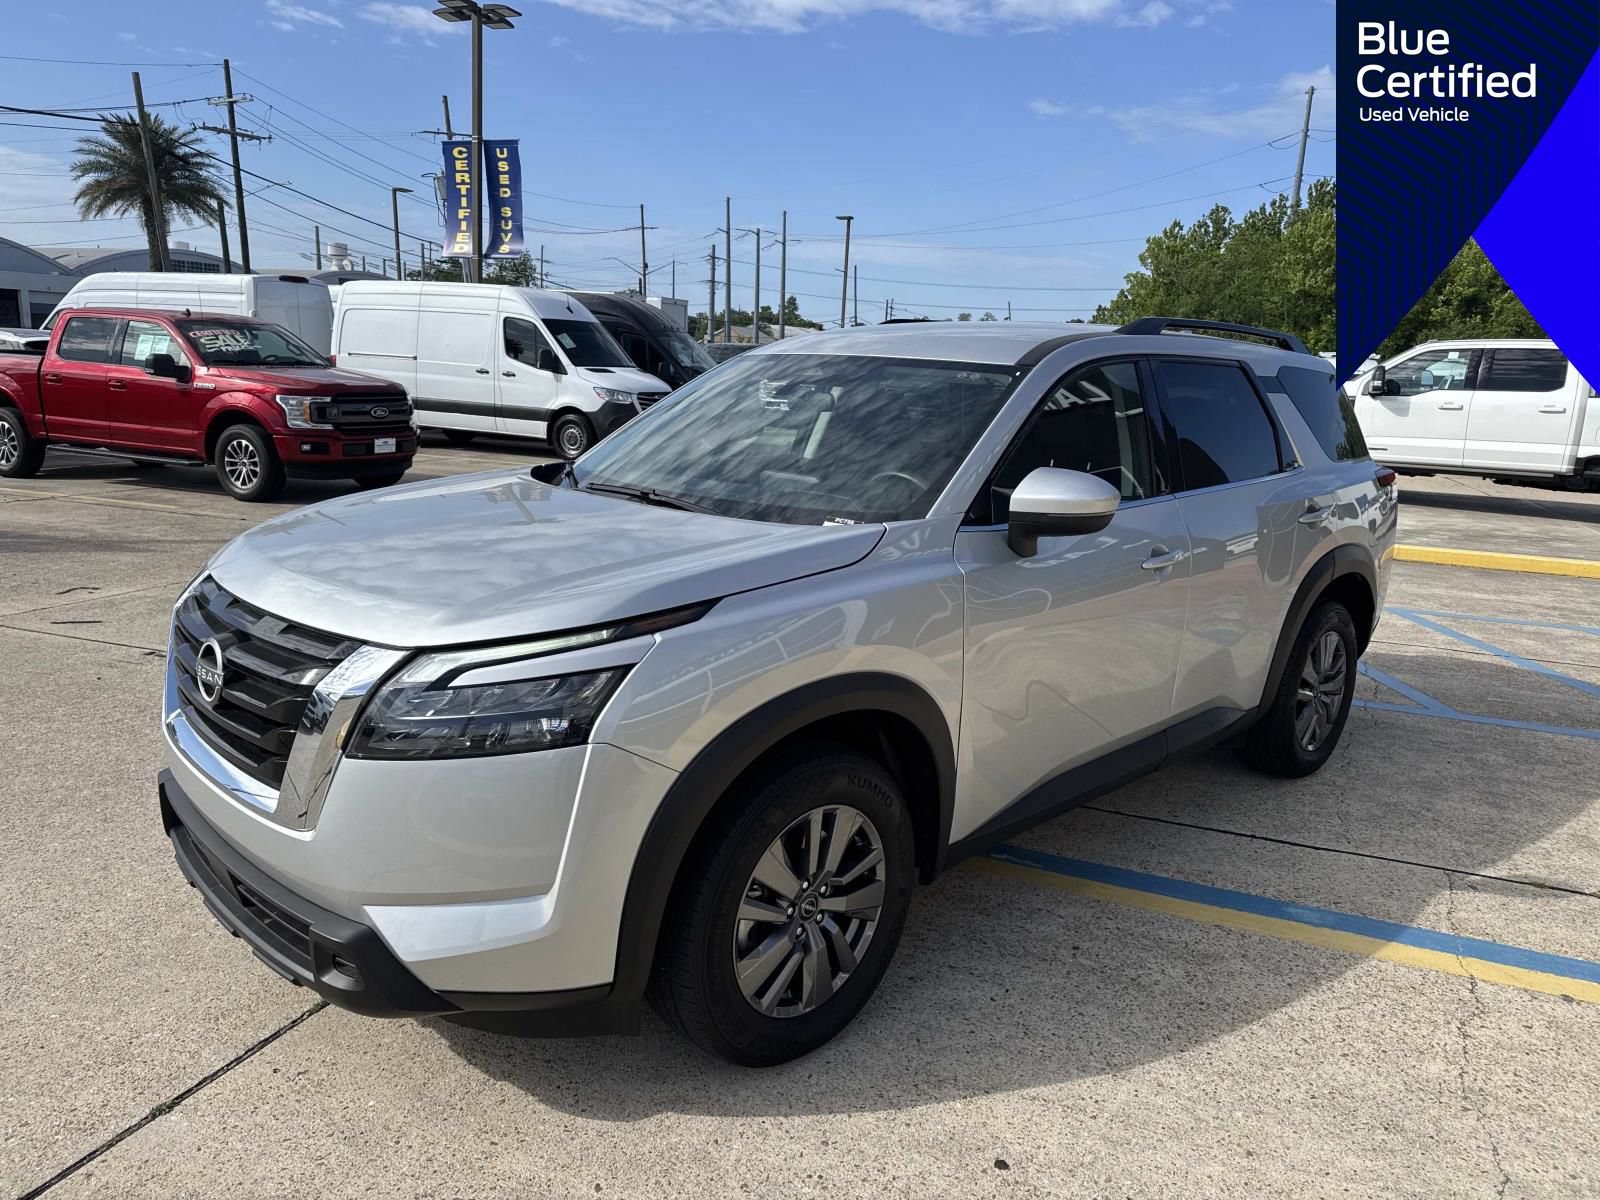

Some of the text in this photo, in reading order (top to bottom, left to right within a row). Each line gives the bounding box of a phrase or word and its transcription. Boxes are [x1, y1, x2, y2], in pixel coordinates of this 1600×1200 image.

[452, 146, 471, 253] CERTIFIED
[495, 147, 513, 253] USED SUVS
[847, 774, 893, 808] KUMHO
